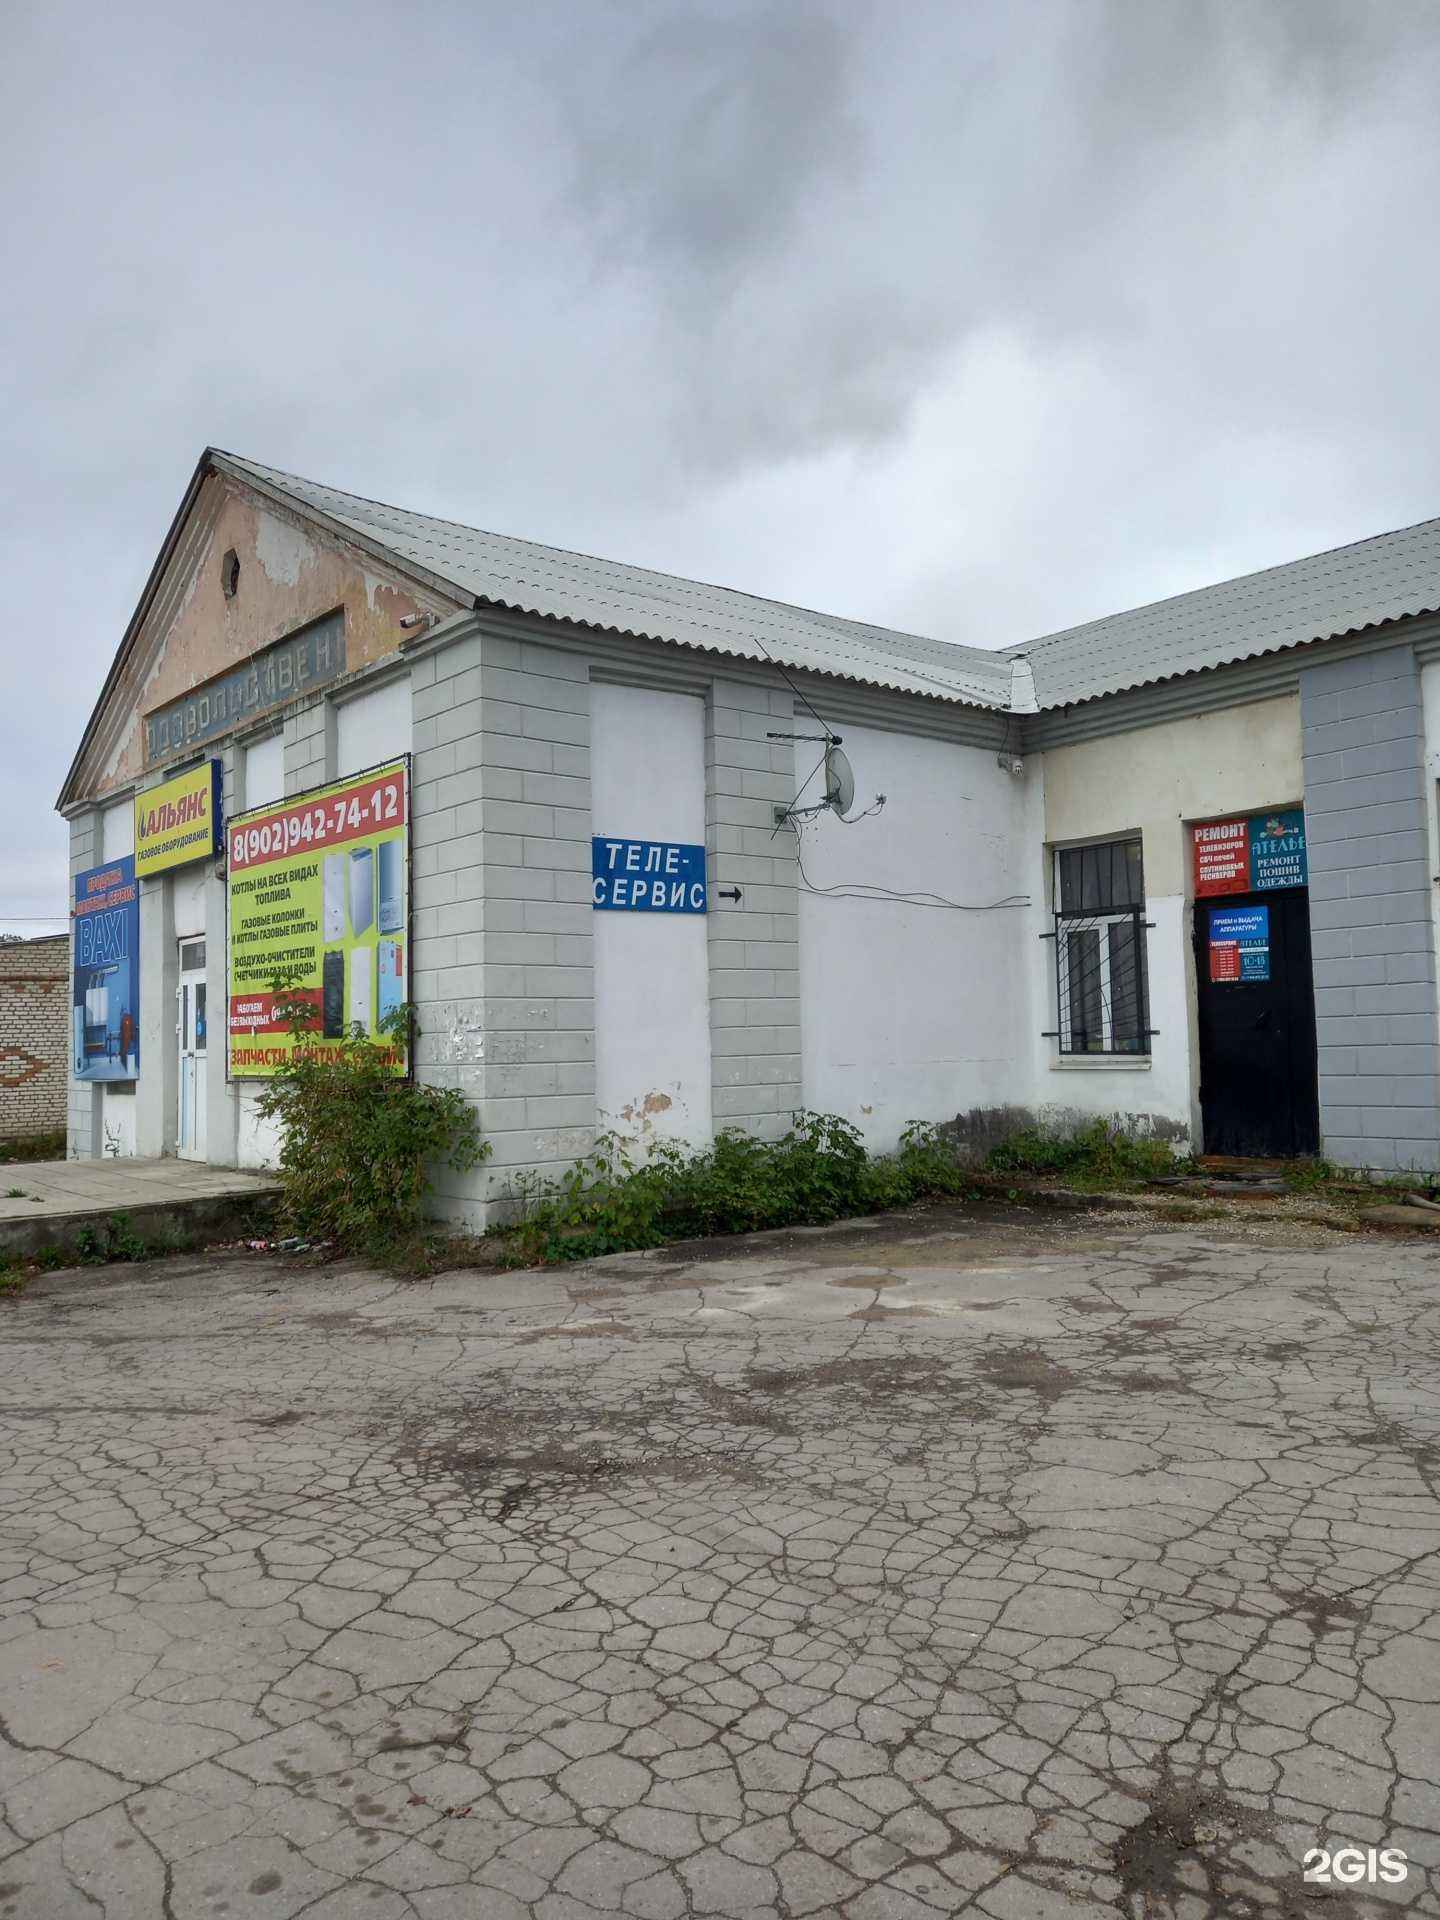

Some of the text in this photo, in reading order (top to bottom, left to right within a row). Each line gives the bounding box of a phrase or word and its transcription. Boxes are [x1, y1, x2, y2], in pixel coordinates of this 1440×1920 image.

[147, 787, 208, 837] АЛЬЯНС
[233, 784, 398, 864] 8(902)942-74-12
[1194, 823, 1246, 842] РЕМОНТ
[137, 828, 209, 862] ГАЗОВОЕ ОБОРУДОВАНИЕ
[1252, 836, 1306, 856] АТЕЛЬЕ
[606, 843, 689, 873] ТЕЛЕ-
[1257, 854, 1301, 868] РЕМОНТ
[231, 863, 319, 895] КОТЛЫ НА ВСЕХ ВИДАХ
[1257, 875, 1303, 888] ОДЕЖДЫ
[1259, 865, 1300, 877] ПОШИВ
[254, 888, 291, 906] ТОПЛИВА
[592, 877, 704, 908] СЕРВИС
[241, 908, 305, 929] ГАЗОВЫЕ КОЛОНКИ
[80, 908, 129, 967] BAXI
[237, 930, 259, 944] КОТЛЫ
[260, 925, 290, 940] ГАЗОВЫЕ
[291, 920, 318, 935] ПЛИТЫ
[294, 961, 316, 976] ВОДЫ
